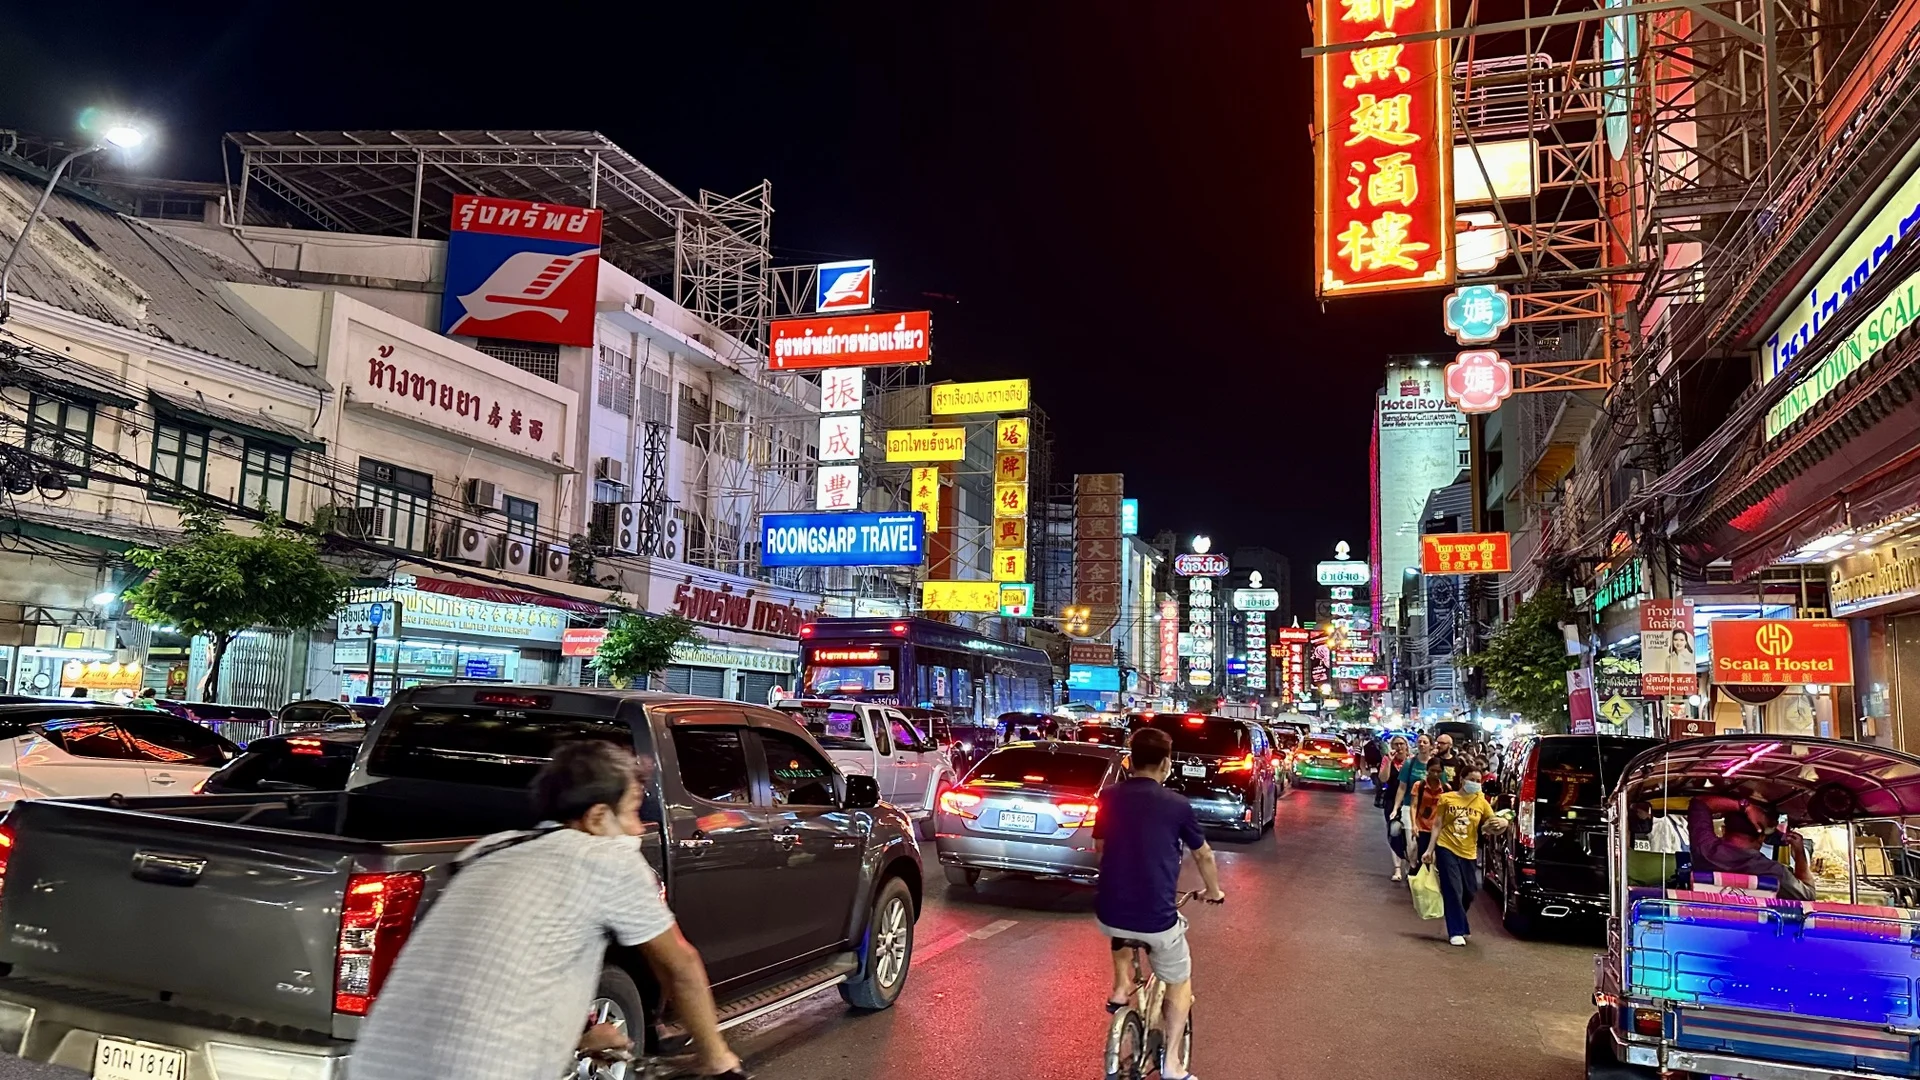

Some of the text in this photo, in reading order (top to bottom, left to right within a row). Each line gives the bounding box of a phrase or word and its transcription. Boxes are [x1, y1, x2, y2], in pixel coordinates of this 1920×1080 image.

[459, 199, 596, 233] รุ่งทรัพย์
[1462, 297, 1494, 326] 媽
[774, 314, 924, 368] รุ่งทรัพย์การท่องเที่ยว
[368, 345, 481, 422] ห้างขายยา
[1462, 365, 1495, 395] 媽
[1770, 386, 1810, 436] CHINA
[1814, 334, 1862, 397] TOWN
[1381, 398, 1417, 411] Hotel
[824, 375, 860, 509] 振成豐
[888, 431, 963, 453] เอกไทยรังนก
[767, 524, 918, 554] ROONGSARP TRAVEL
[1647, 605, 1686, 617] ทำงาน
[1719, 656, 1834, 671] Scala Hostel
[1676, 676, 1695, 684] ส.ส.
[1017, 814, 1035, 824] 6000
[101, 1045, 176, 1079] 9กม 1814
